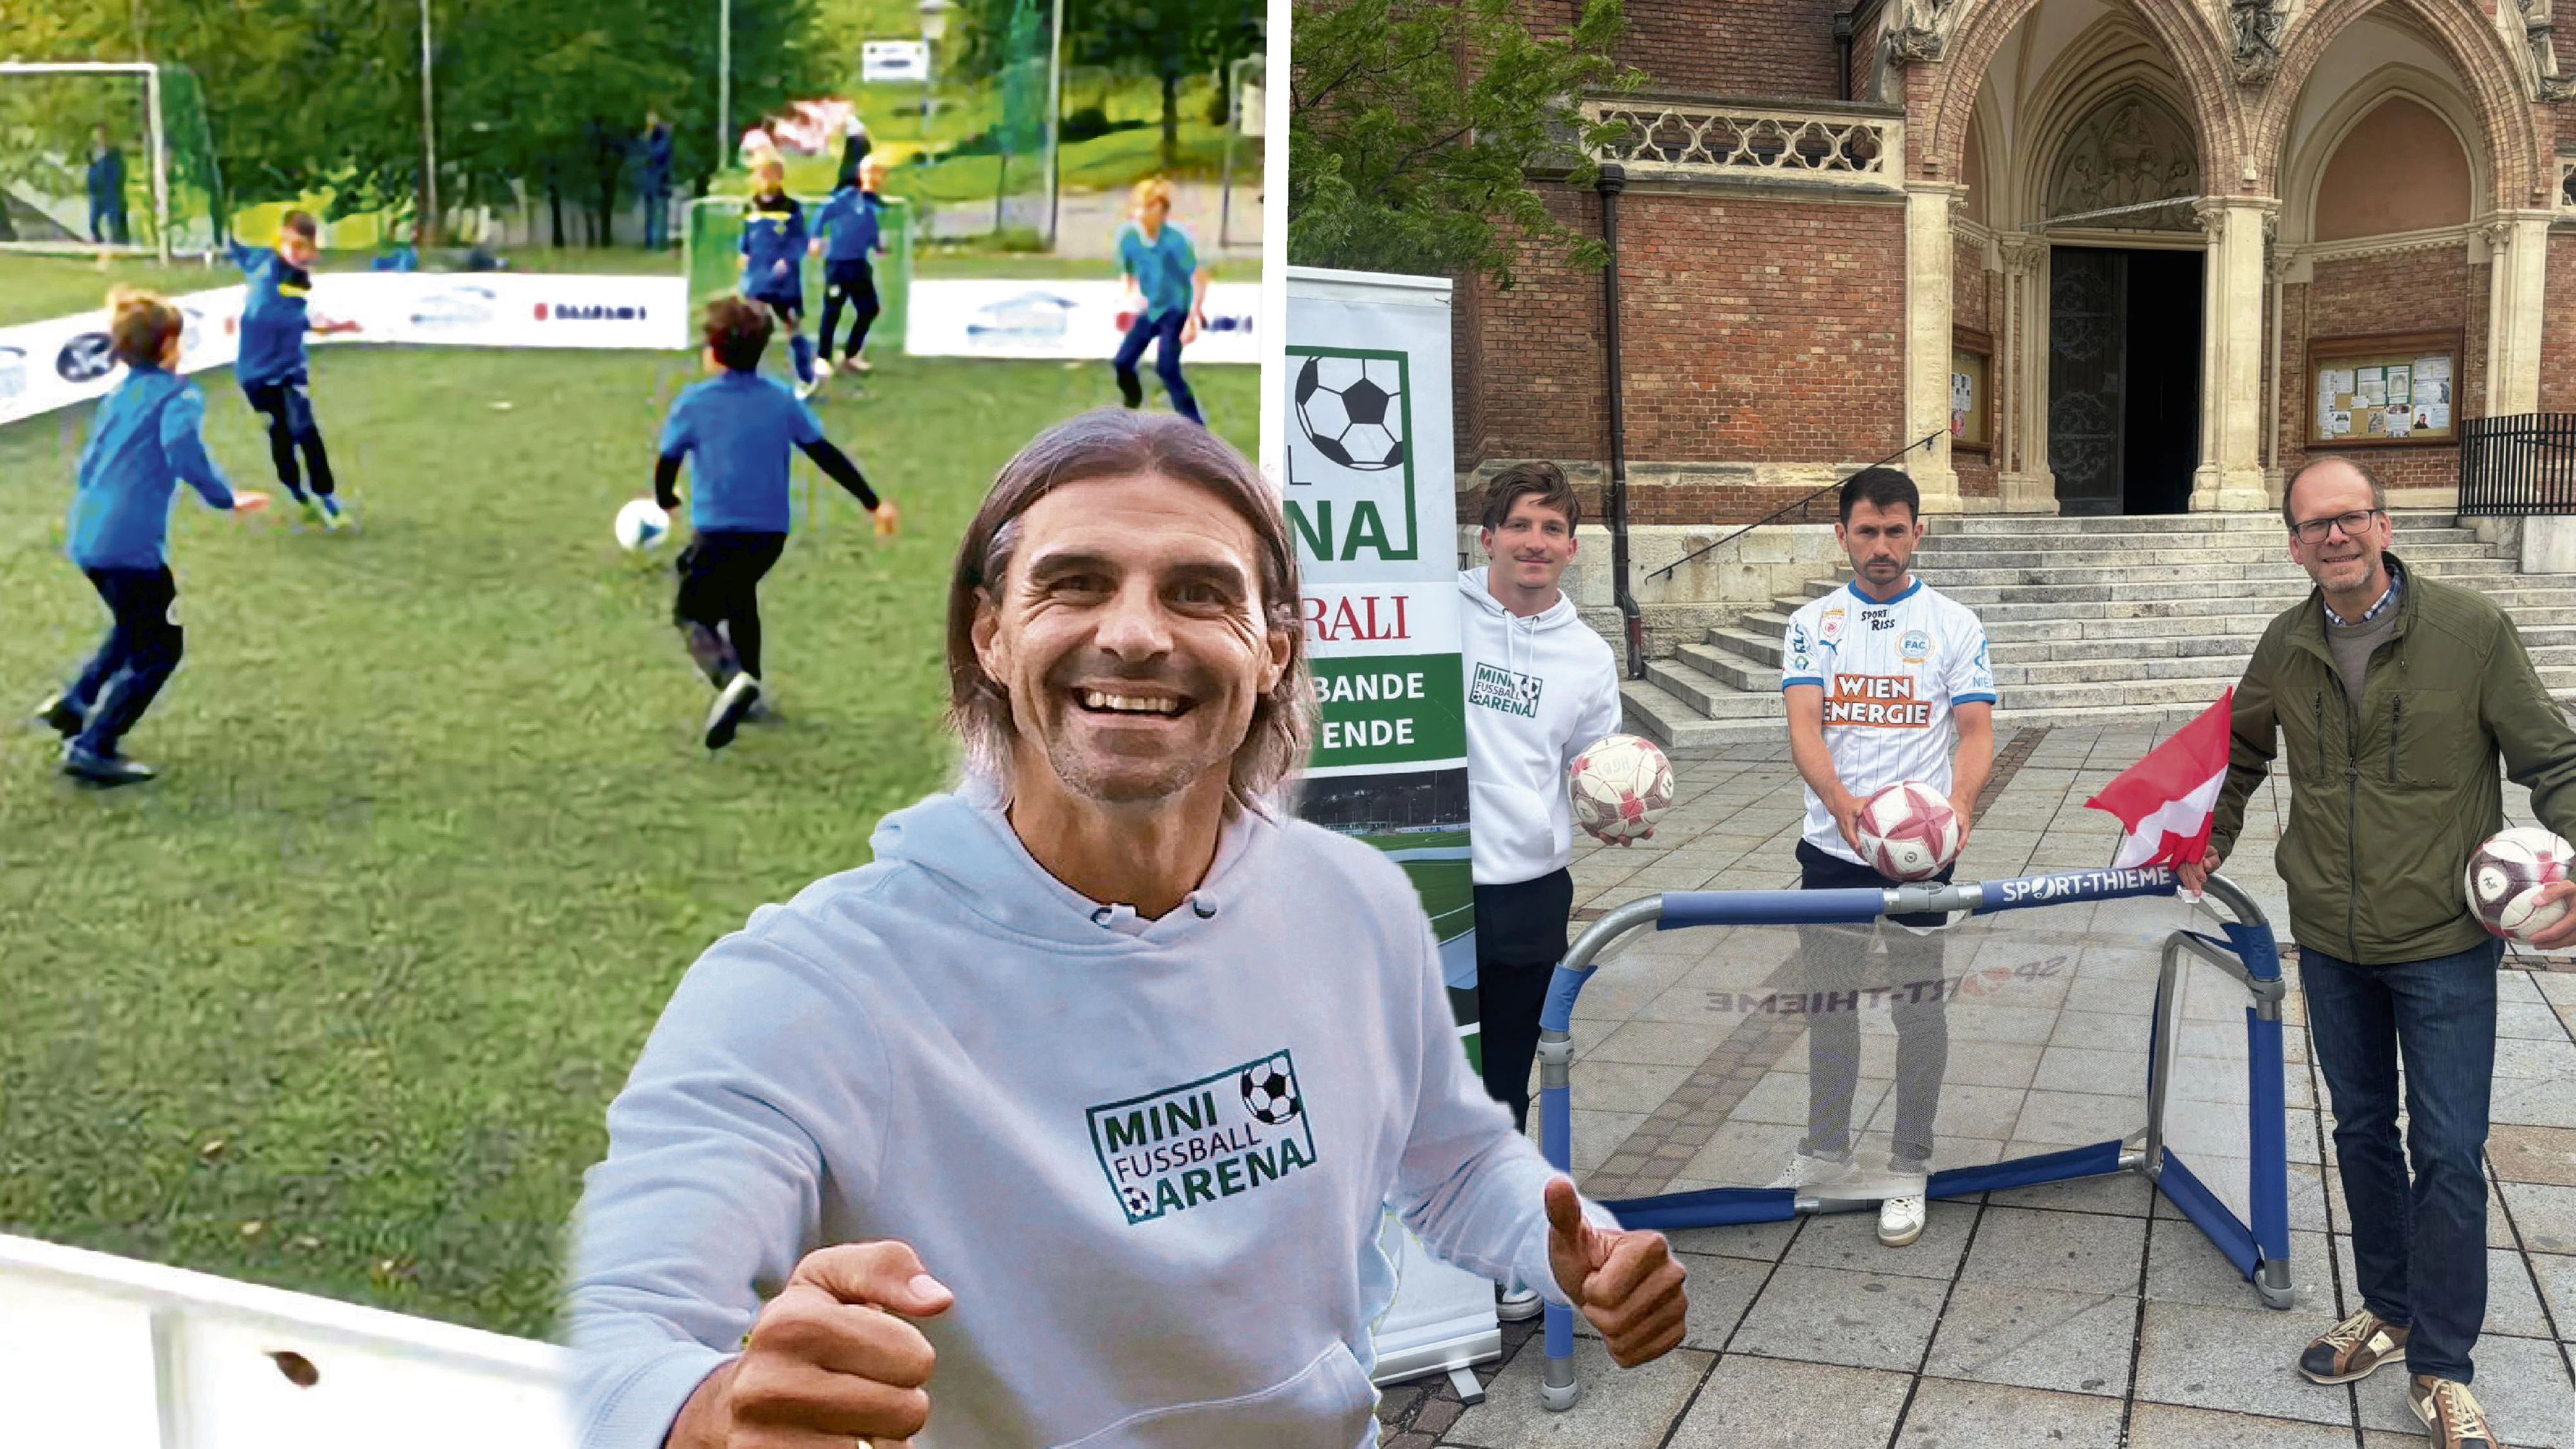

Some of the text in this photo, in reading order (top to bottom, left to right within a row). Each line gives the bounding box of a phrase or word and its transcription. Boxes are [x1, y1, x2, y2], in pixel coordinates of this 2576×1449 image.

[1861, 609, 1888, 621] SPORT
[1871, 619, 1895, 630] RISS
[1478, 667, 1512, 687] MINI
[1838, 676, 1910, 699] WIEN
[1476, 681, 1520, 700] FUSSBALL
[1482, 694, 1530, 717] ARENA
[1823, 701, 1929, 724] ENERGIE
[1104, 1090, 1217, 1153] MINI
[1113, 1122, 1262, 1182] FUSSBALL
[1157, 1138, 1306, 1215] ARENA
